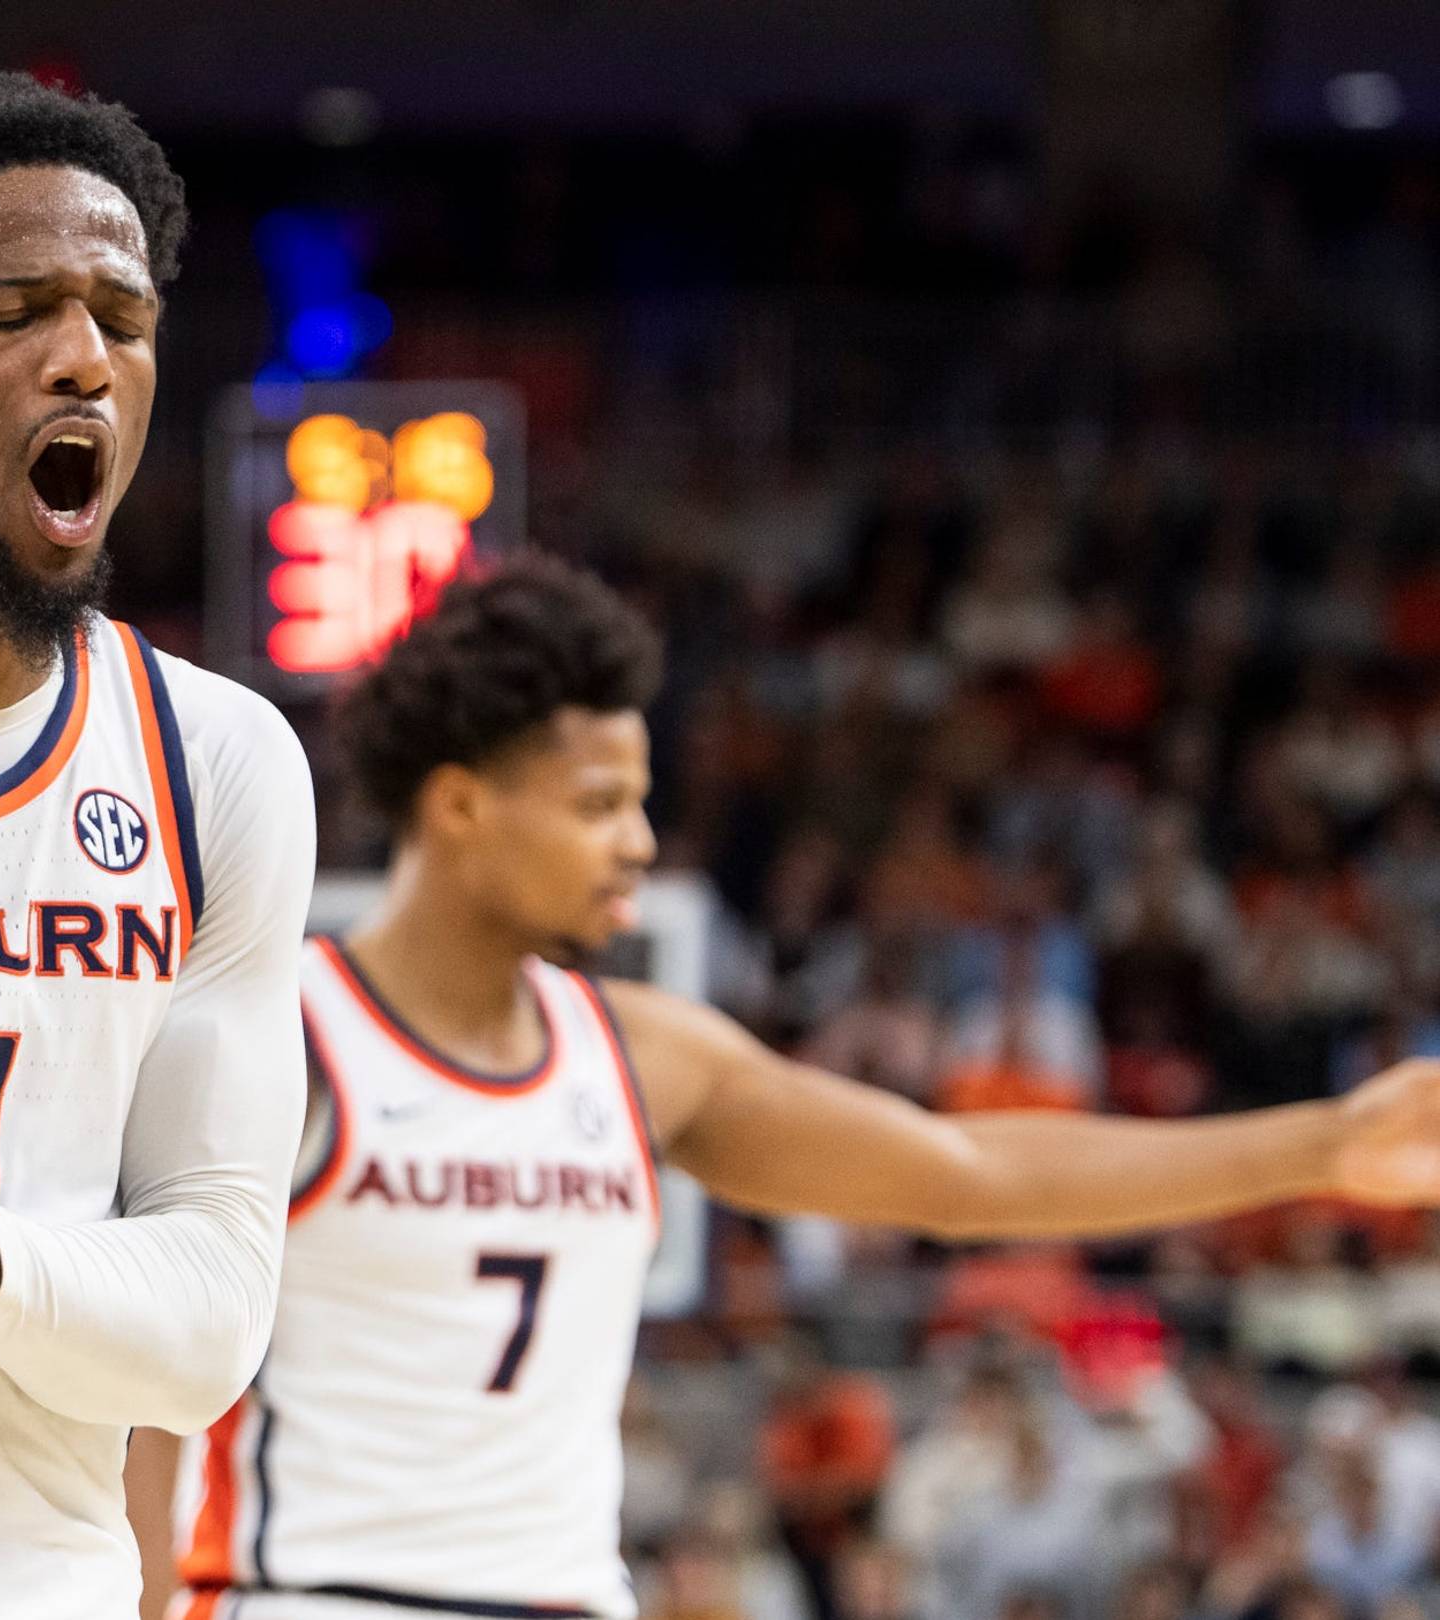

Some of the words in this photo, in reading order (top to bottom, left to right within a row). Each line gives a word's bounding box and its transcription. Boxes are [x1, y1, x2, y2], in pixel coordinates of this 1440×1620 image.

[77, 792, 145, 868] SEC
[346, 1155, 637, 1212] AUBURN
[474, 1251, 550, 1393] 7
